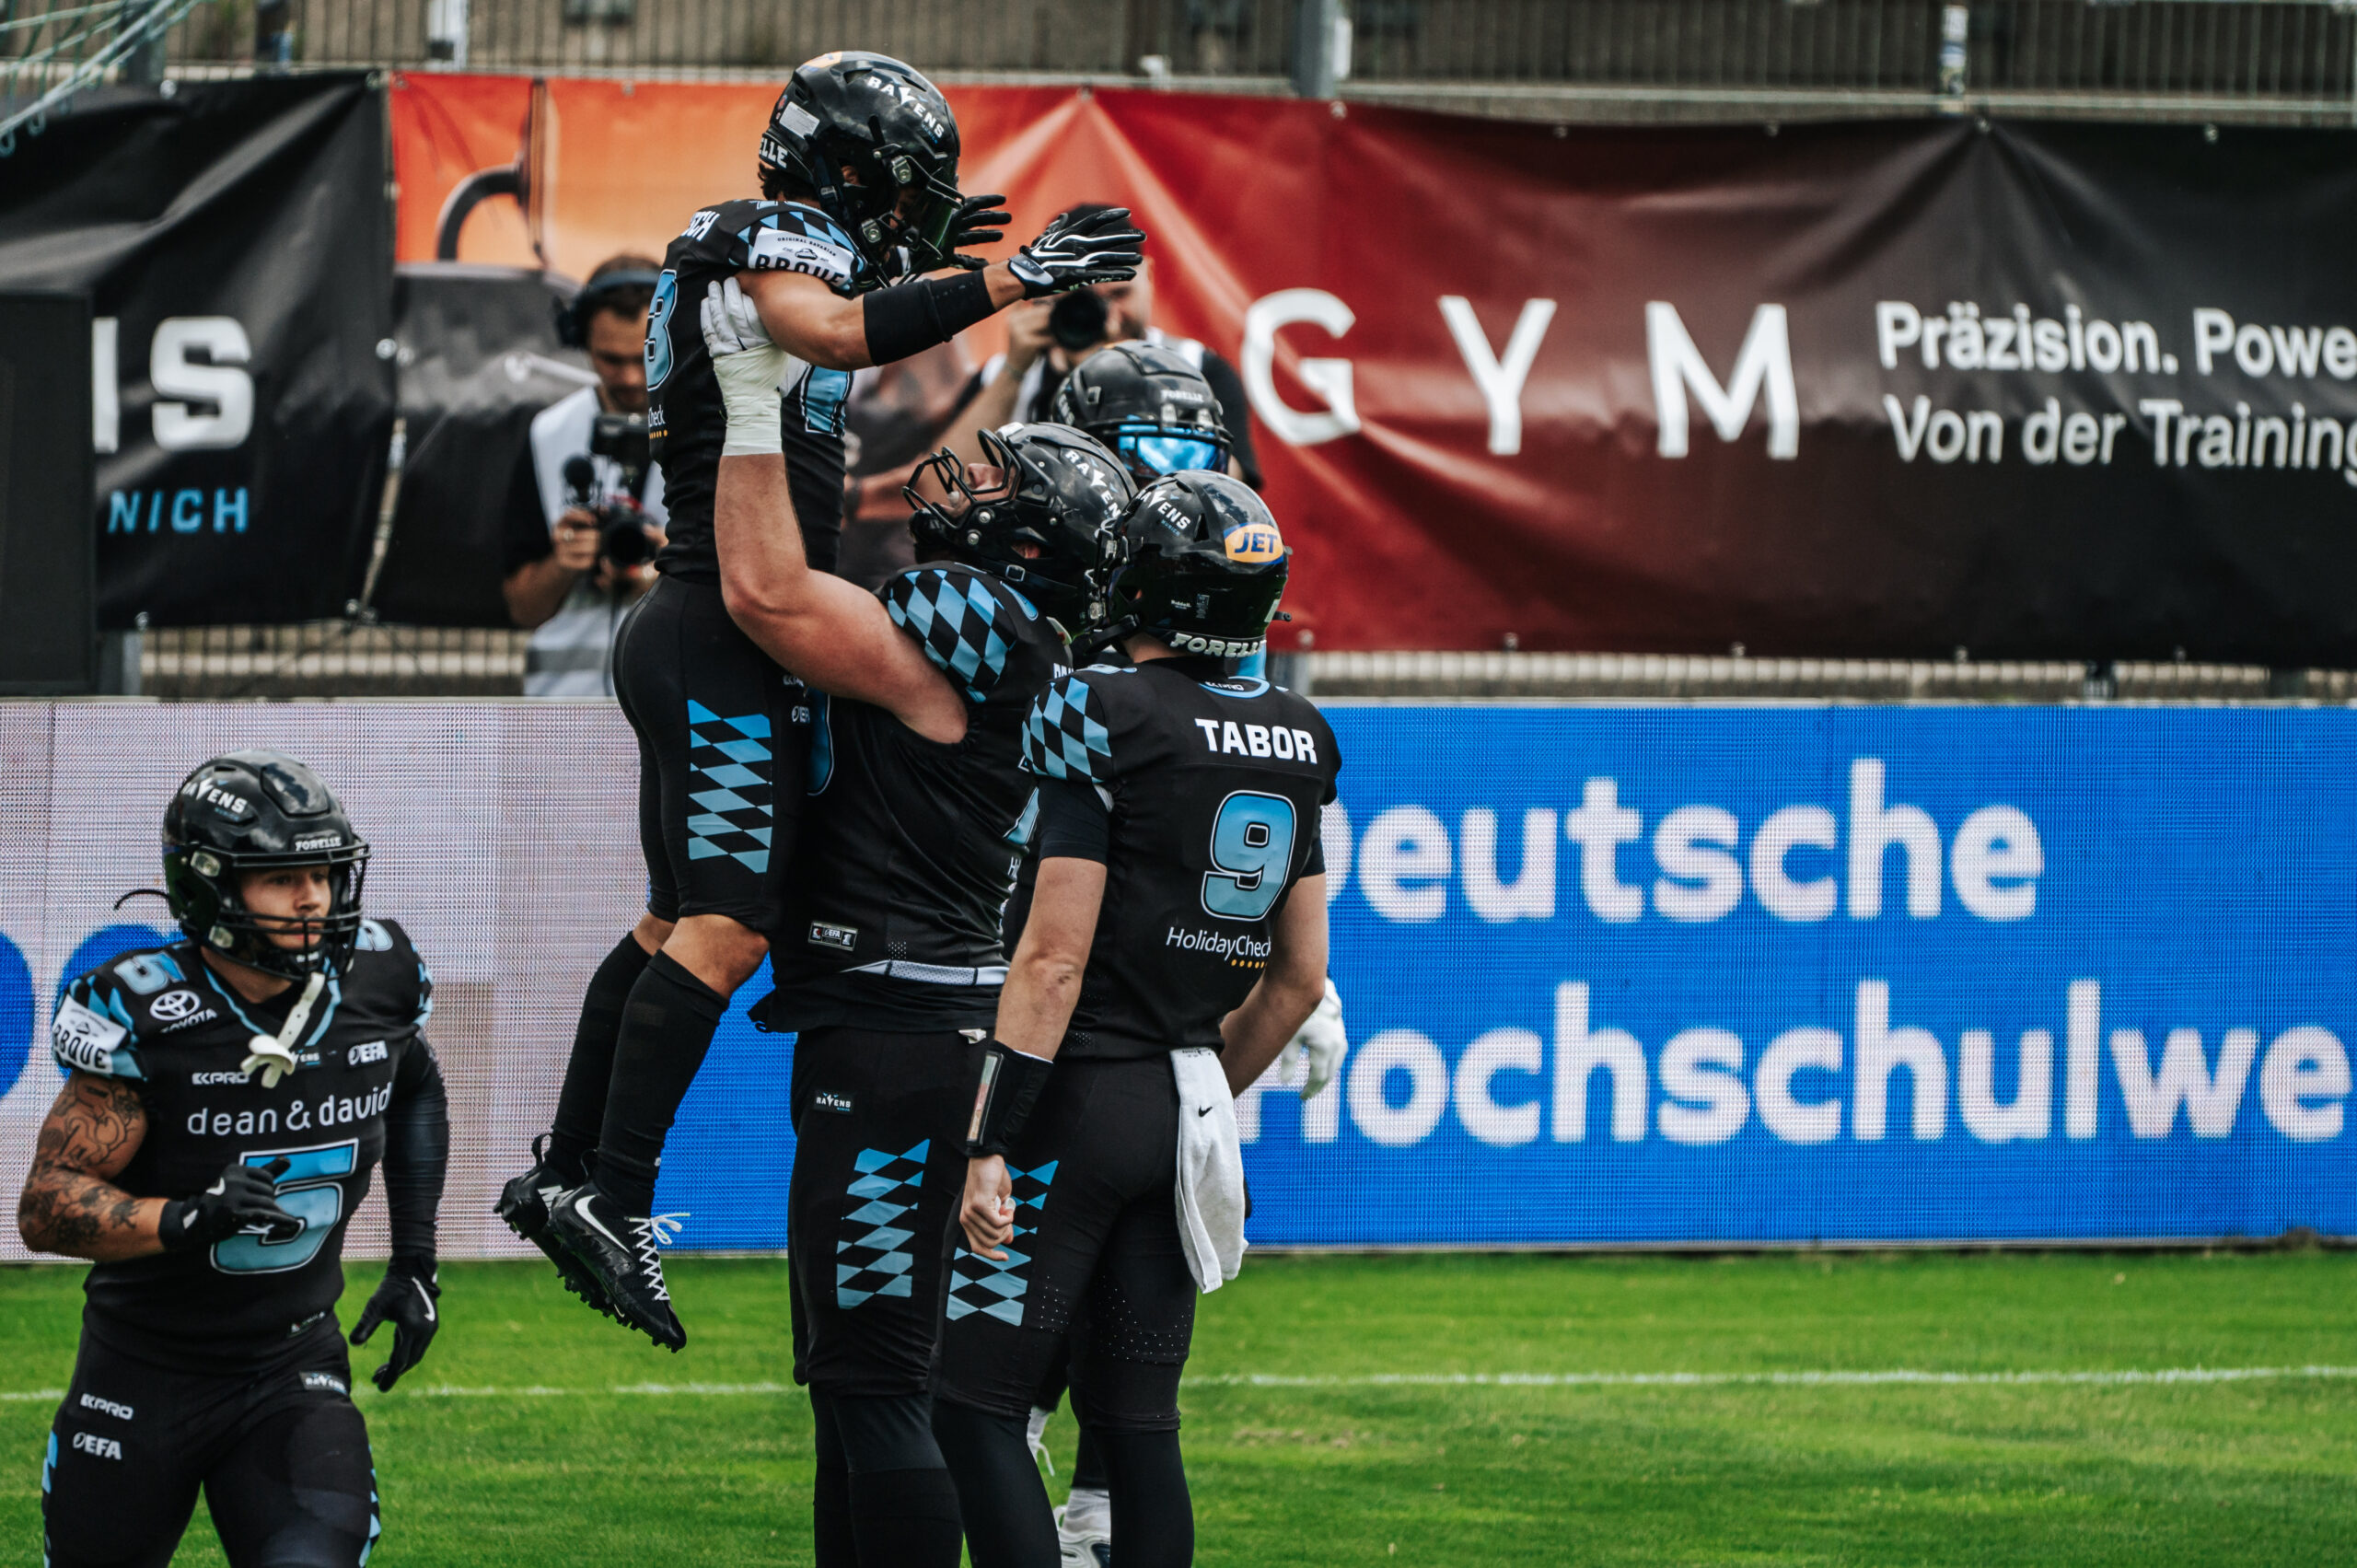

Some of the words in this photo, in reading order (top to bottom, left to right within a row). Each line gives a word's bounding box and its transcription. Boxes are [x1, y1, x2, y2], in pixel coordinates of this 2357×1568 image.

[867, 75, 945, 139] RAVENS
[1875, 300, 2179, 375] Präzision.
[2193, 308, 2357, 379] Powe
[1882, 394, 2004, 462] Von
[2023, 396, 2126, 464] der
[108, 486, 250, 534] NICH
[1064, 449, 1122, 519] RAVEN
[1234, 532, 1278, 553] JET
[1194, 717, 1318, 765] TABOR
[1201, 789, 1297, 922] 9
[159, 1007, 218, 1034] TOYOTA
[187, 1107, 277, 1137] dean
[285, 1099, 311, 1131] &
[319, 1081, 392, 1127] david
[816, 1094, 852, 1109] RAVENS
[210, 1138, 359, 1274] 5
